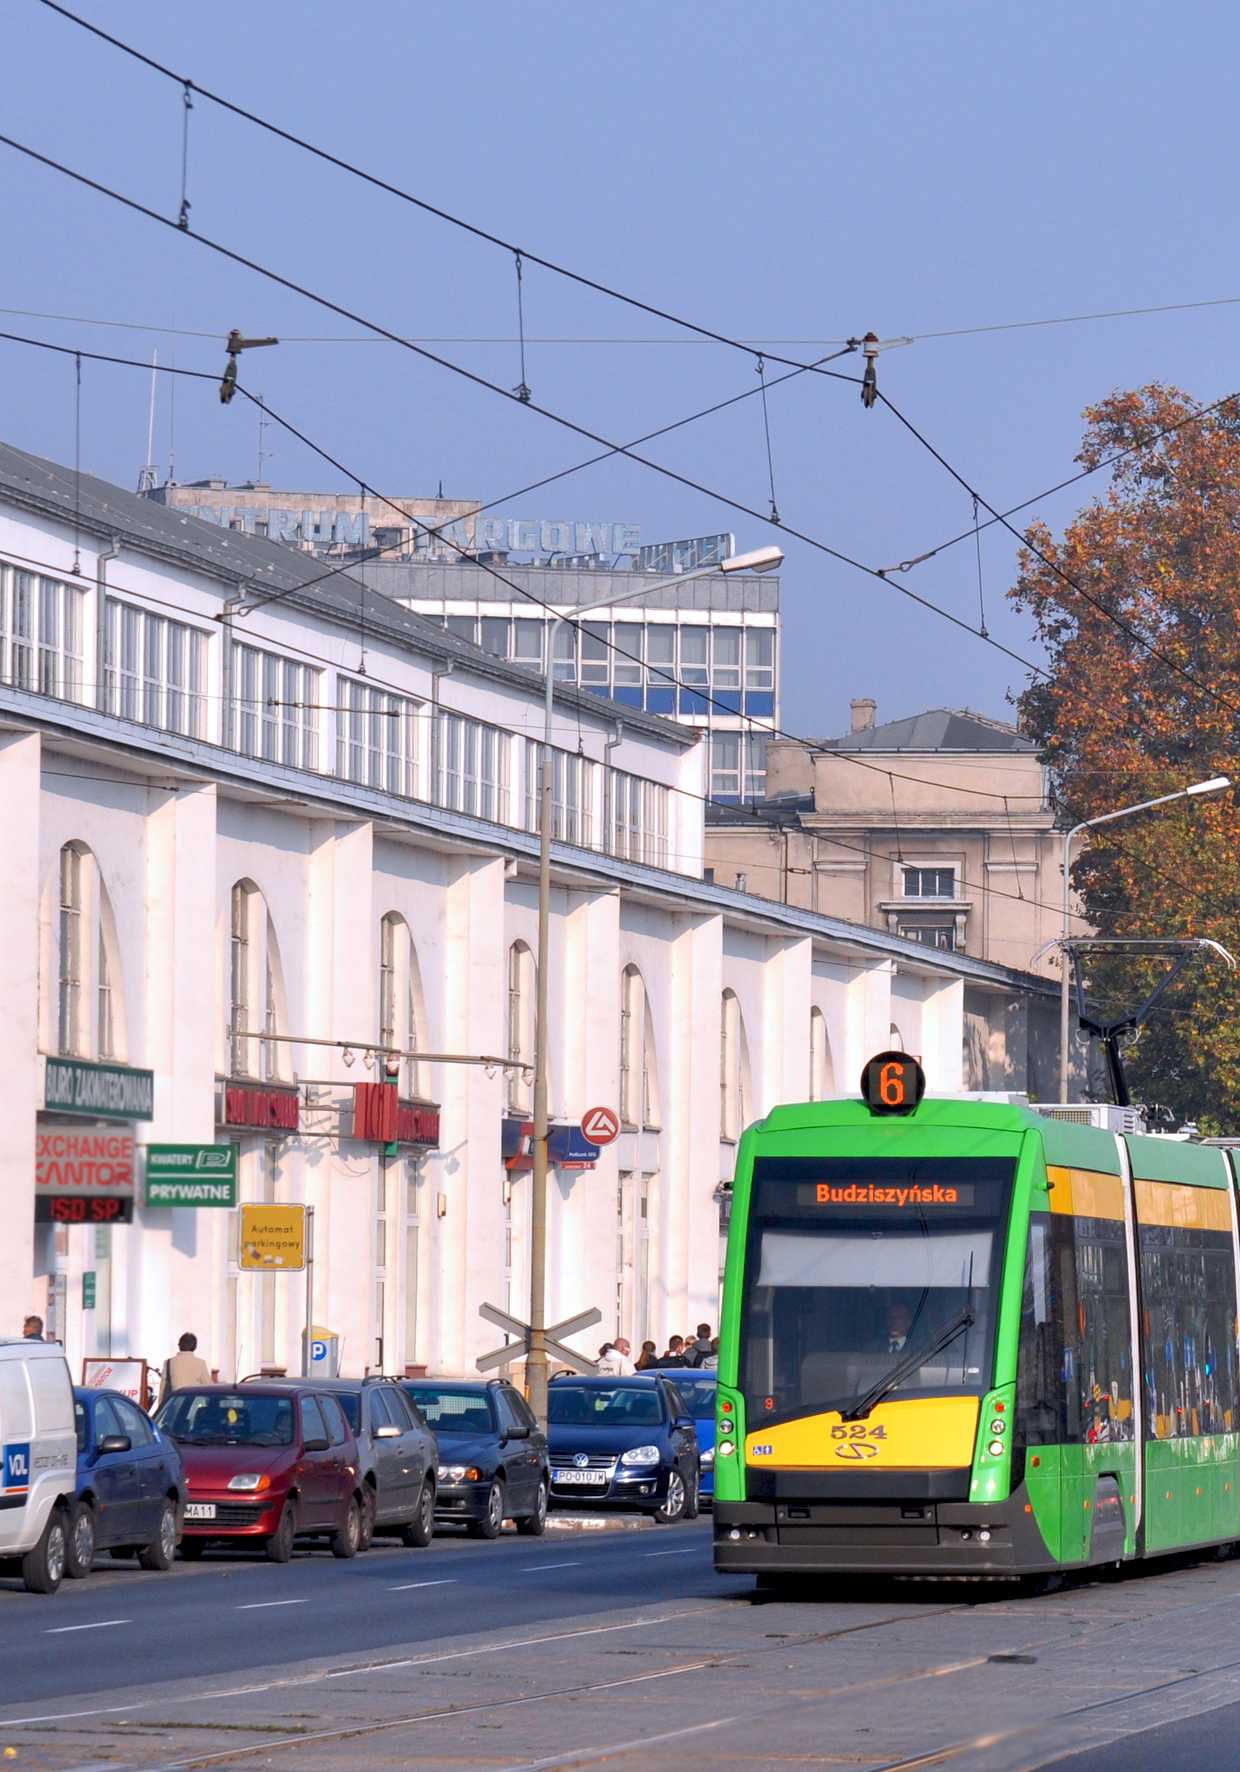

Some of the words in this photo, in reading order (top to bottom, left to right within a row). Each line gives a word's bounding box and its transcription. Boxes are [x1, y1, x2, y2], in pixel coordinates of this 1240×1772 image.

[880, 1062, 905, 1106] 6
[150, 1184, 231, 1200] PRYWATNE
[815, 1183, 958, 1207] Budziszyńska
[251, 1224, 294, 1233] Automat
[830, 1424, 888, 1440] 524
